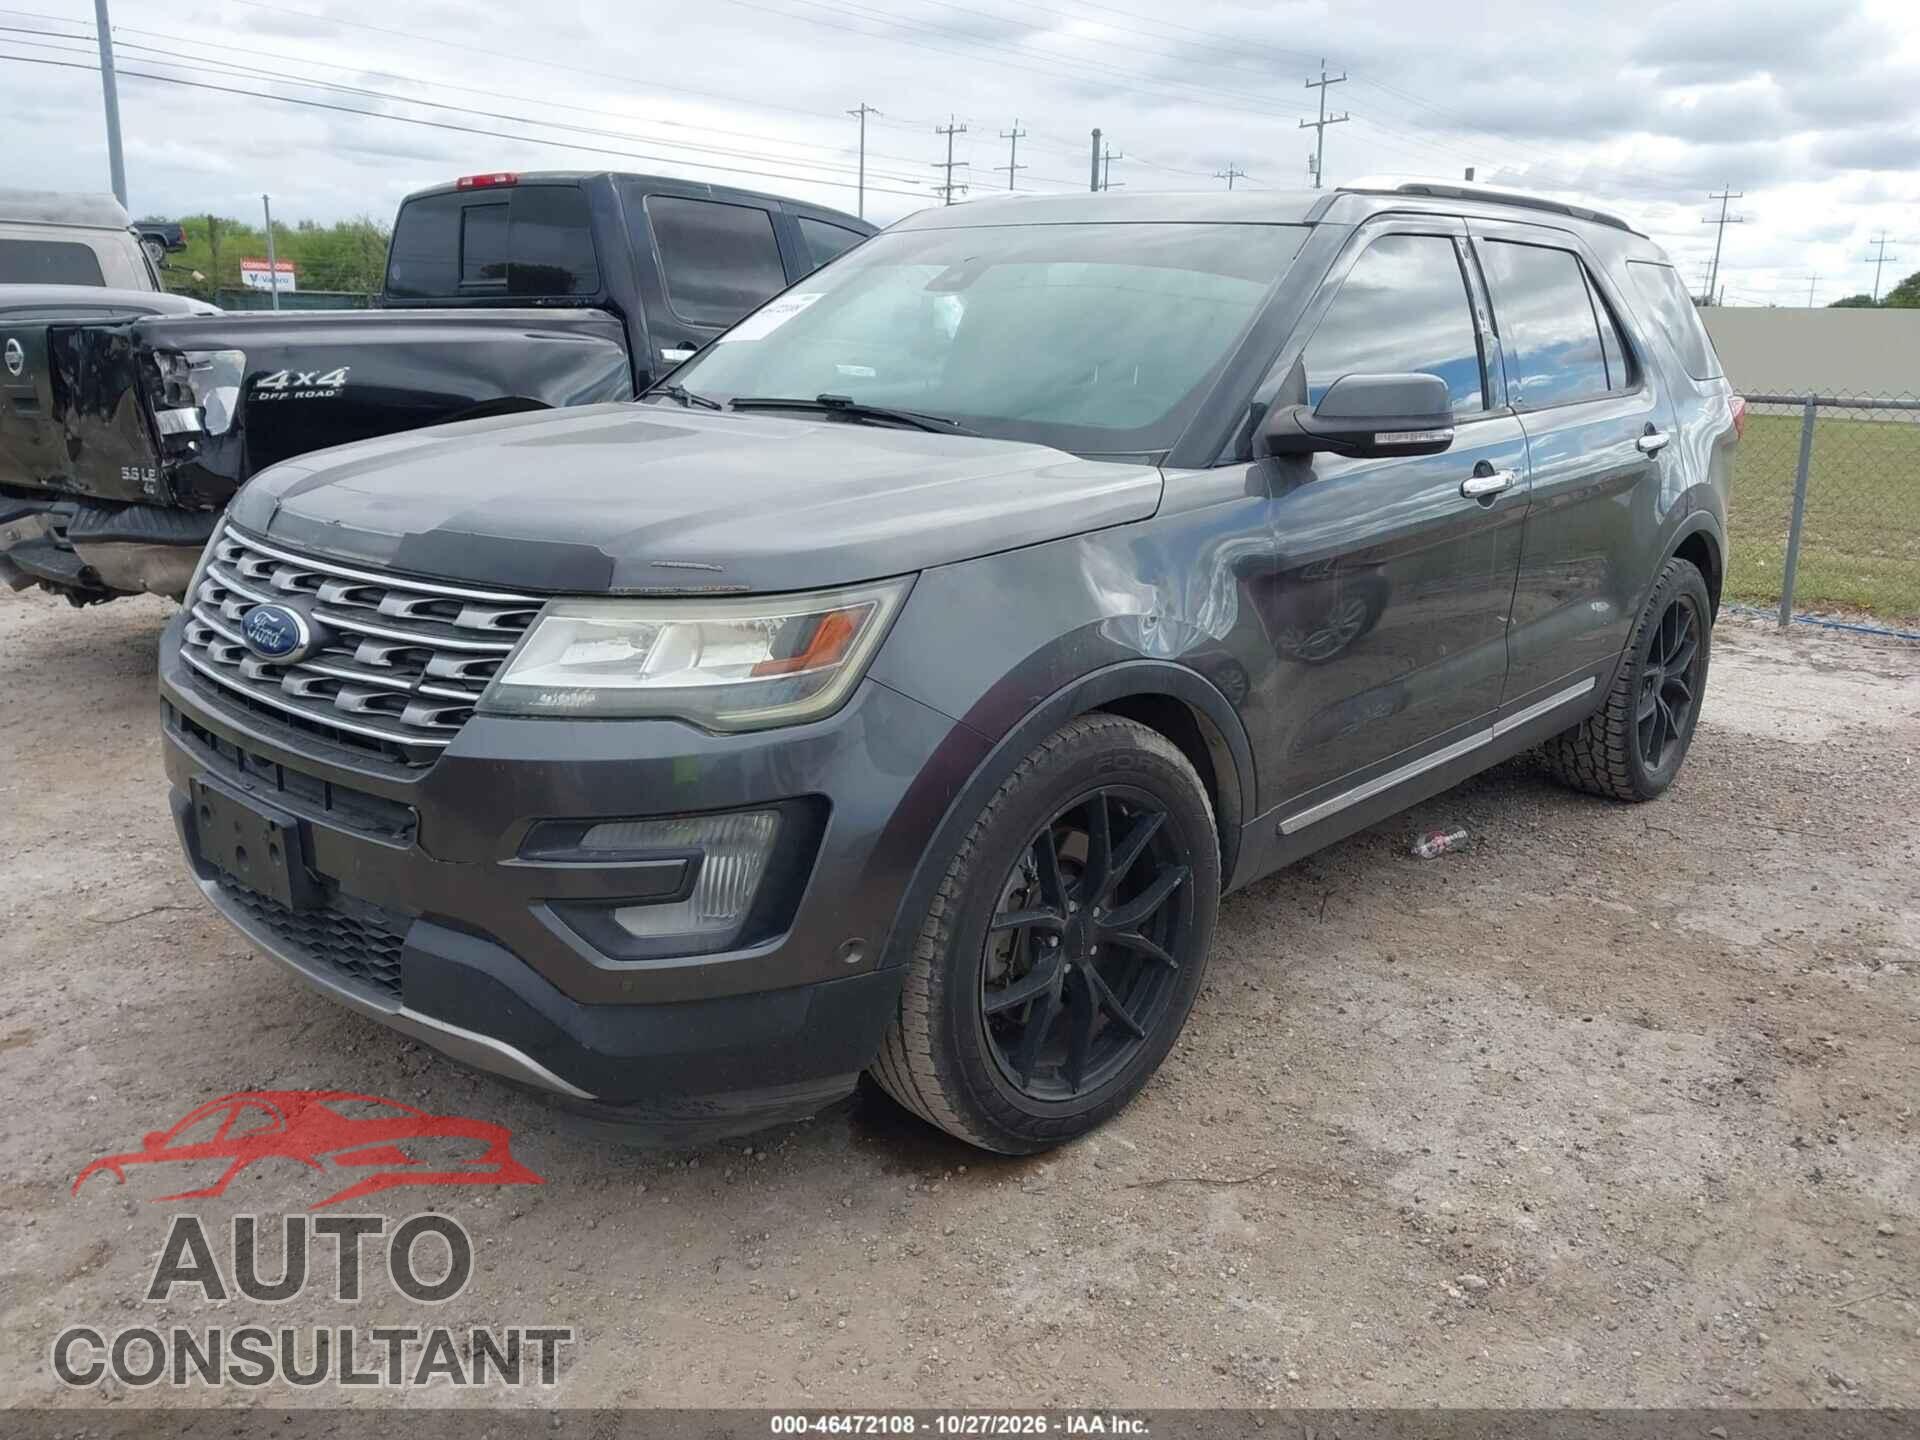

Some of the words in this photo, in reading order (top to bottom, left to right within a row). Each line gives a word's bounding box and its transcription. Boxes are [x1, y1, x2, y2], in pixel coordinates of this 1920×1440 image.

[258, 391, 289, 400] OFF
[294, 390, 335, 399] ROAD
[247, 611, 286, 649] Ford
